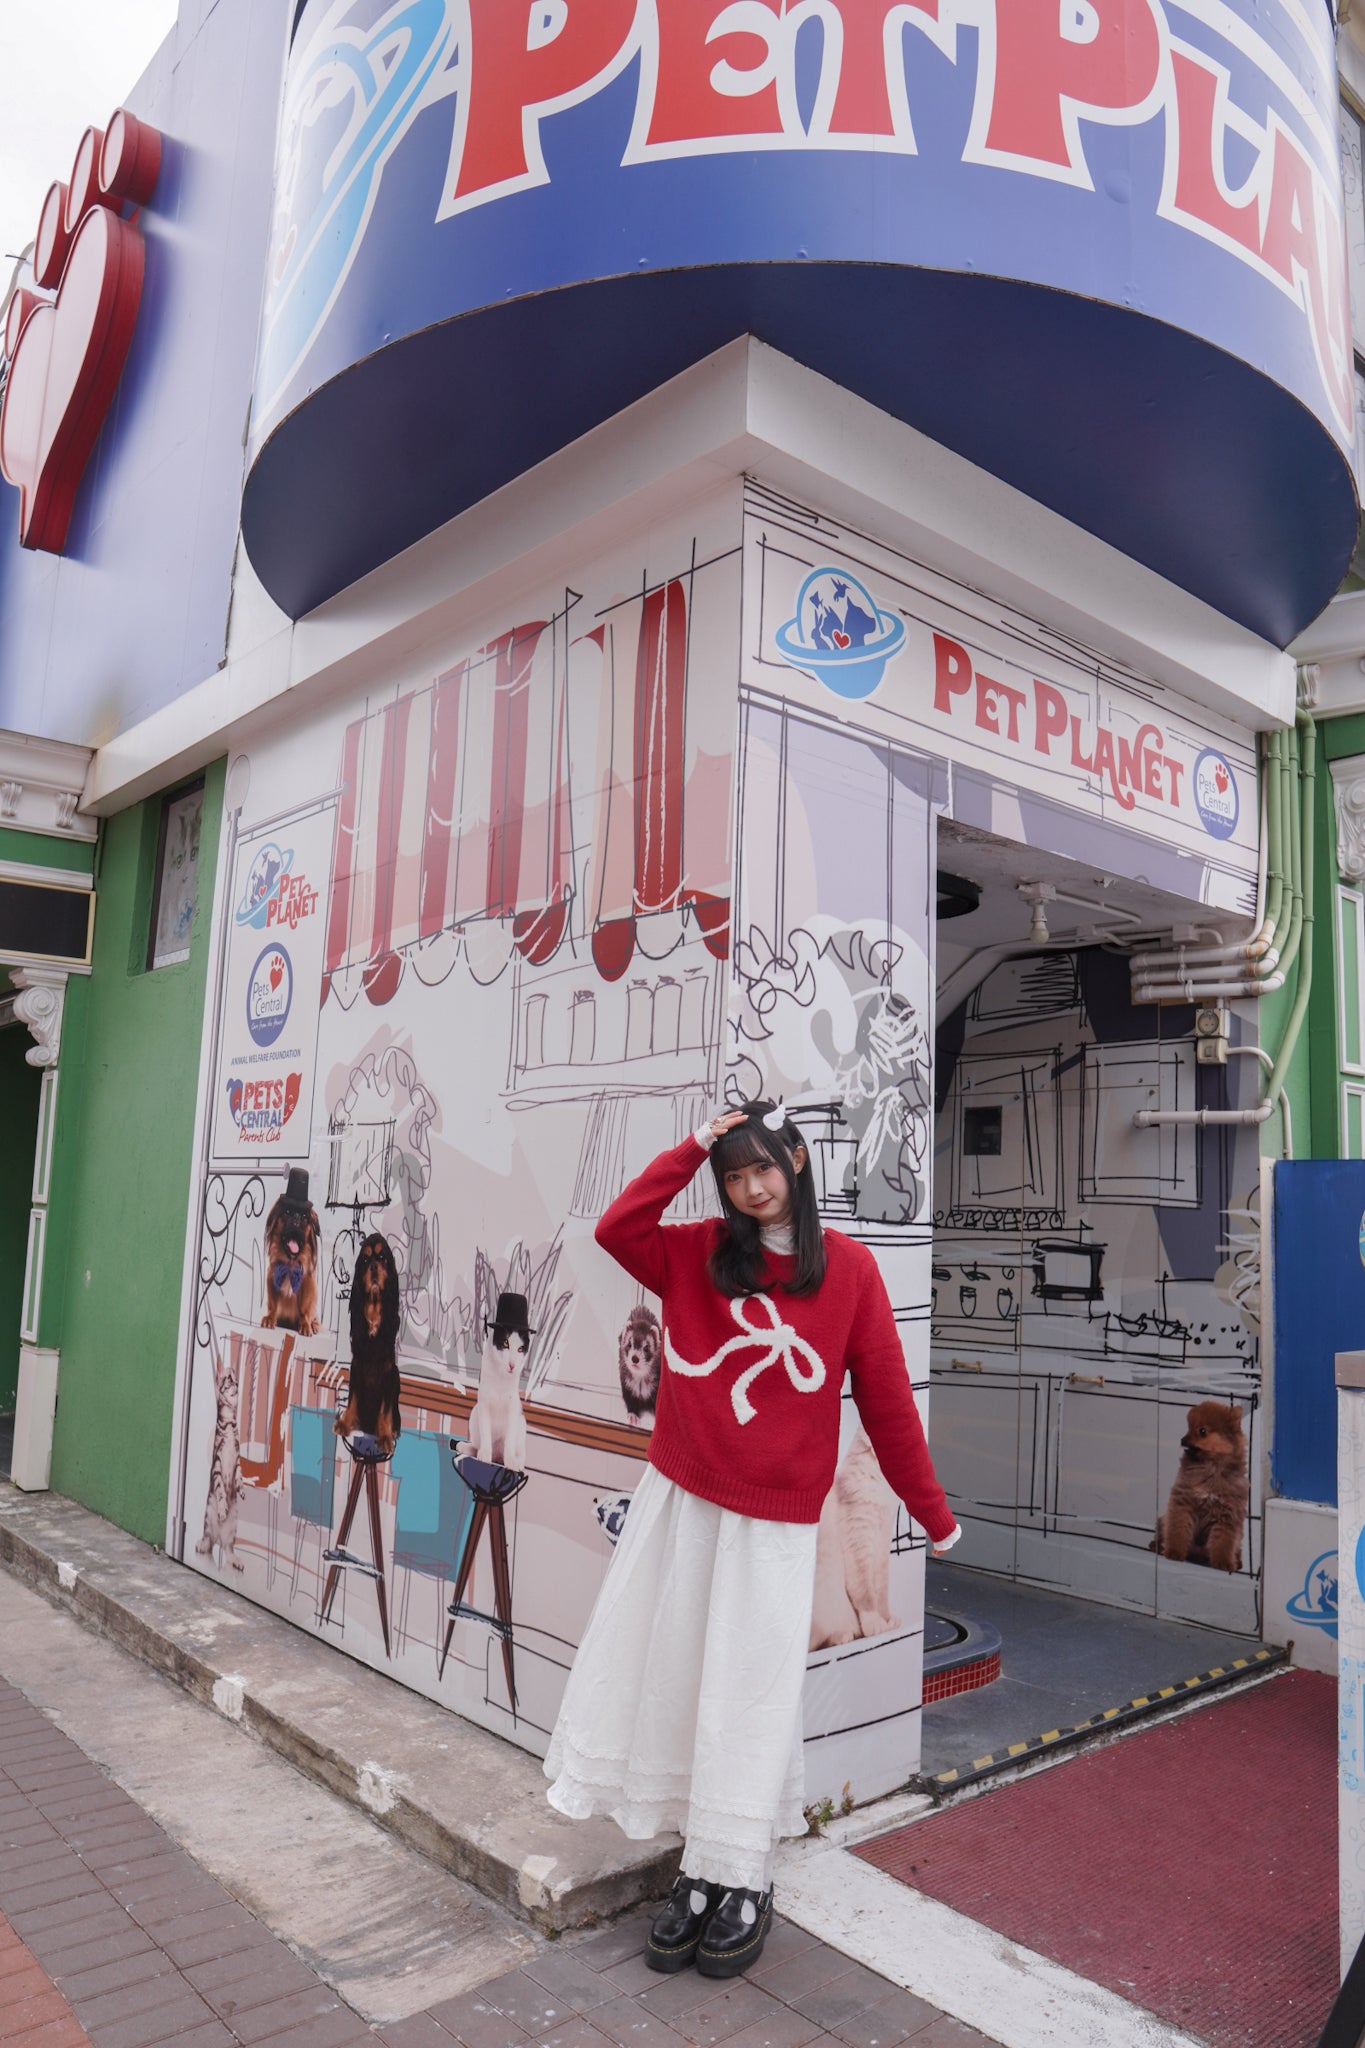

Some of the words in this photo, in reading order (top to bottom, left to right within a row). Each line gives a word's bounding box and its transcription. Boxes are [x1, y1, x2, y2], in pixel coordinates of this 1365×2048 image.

[440, 0, 949, 218] PET
[932, 632, 1026, 743] PET
[1033, 678, 1184, 811] PLANET
[1199, 773, 1216, 793] Pets
[1203, 791, 1231, 814] Central
[278, 873, 305, 903] PET
[266, 883, 319, 930] PLANET
[252, 981, 270, 1001] Pets
[255, 993, 283, 1017] Central
[231, 1056, 248, 1065] ANIMAL
[248, 1053, 269, 1063] WELFARE
[269, 1048, 301, 1060] FOUNDATION
[243, 1079, 283, 1111] PETS
[241, 1109, 283, 1129] CENTRAL
[265, 1126, 281, 1143] Club
